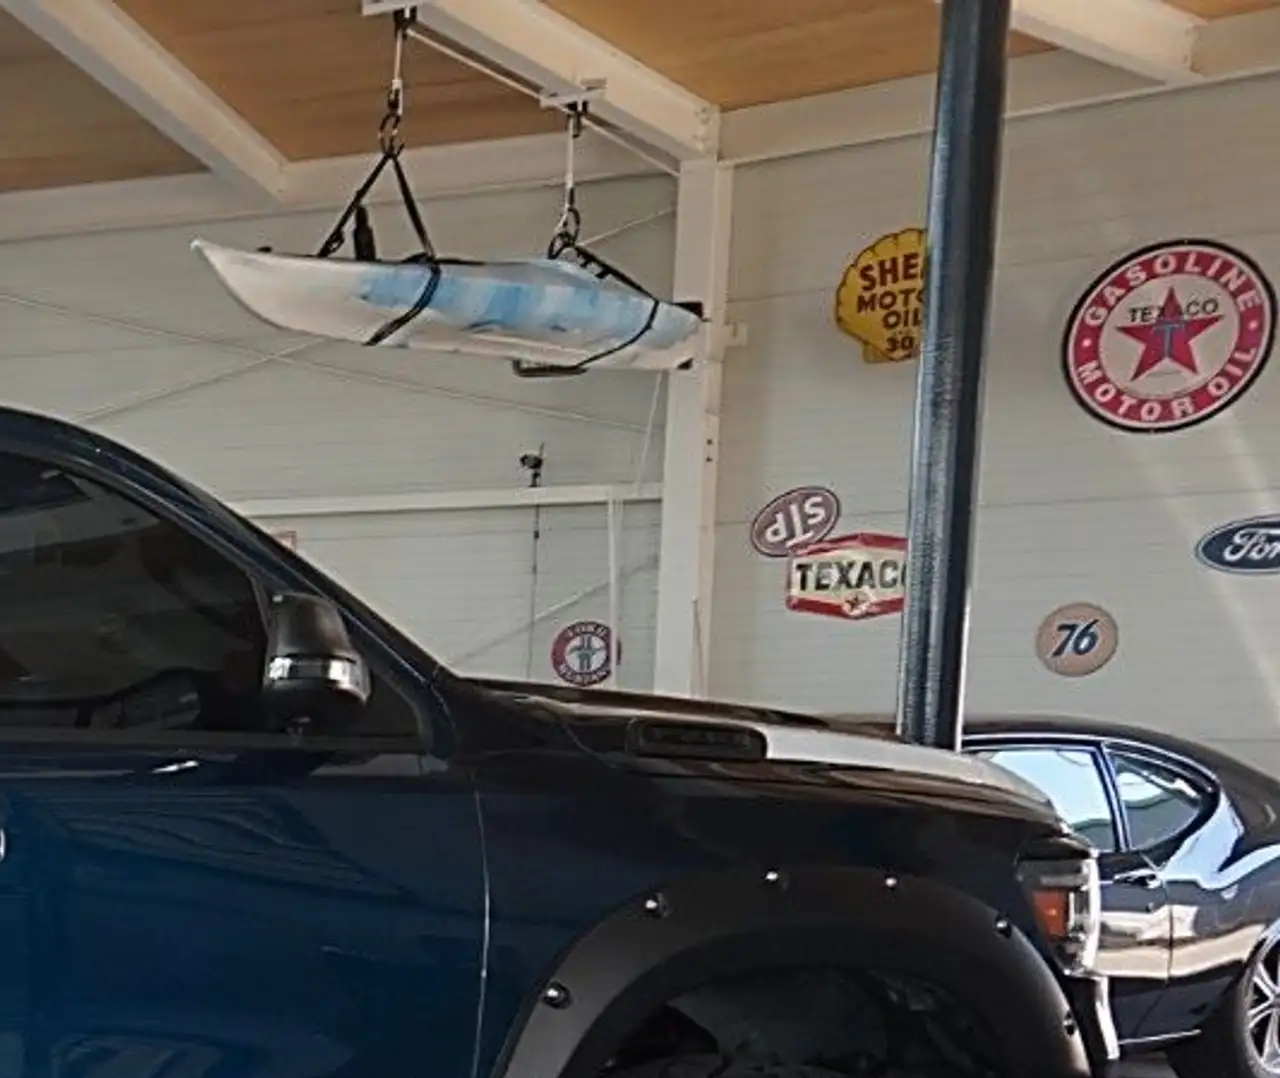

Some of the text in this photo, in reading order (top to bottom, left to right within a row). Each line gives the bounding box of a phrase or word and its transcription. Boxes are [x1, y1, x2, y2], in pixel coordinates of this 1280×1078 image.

[860, 252, 924, 291] SHE
[1084, 251, 1263, 326] GASOLINE
[856, 288, 924, 314] MOT
[1076, 348, 1258, 422] MOTOR OIL
[1222, 528, 1280, 562] For
[794, 560, 908, 592] TEXAC
[1050, 618, 1100, 660] 76
